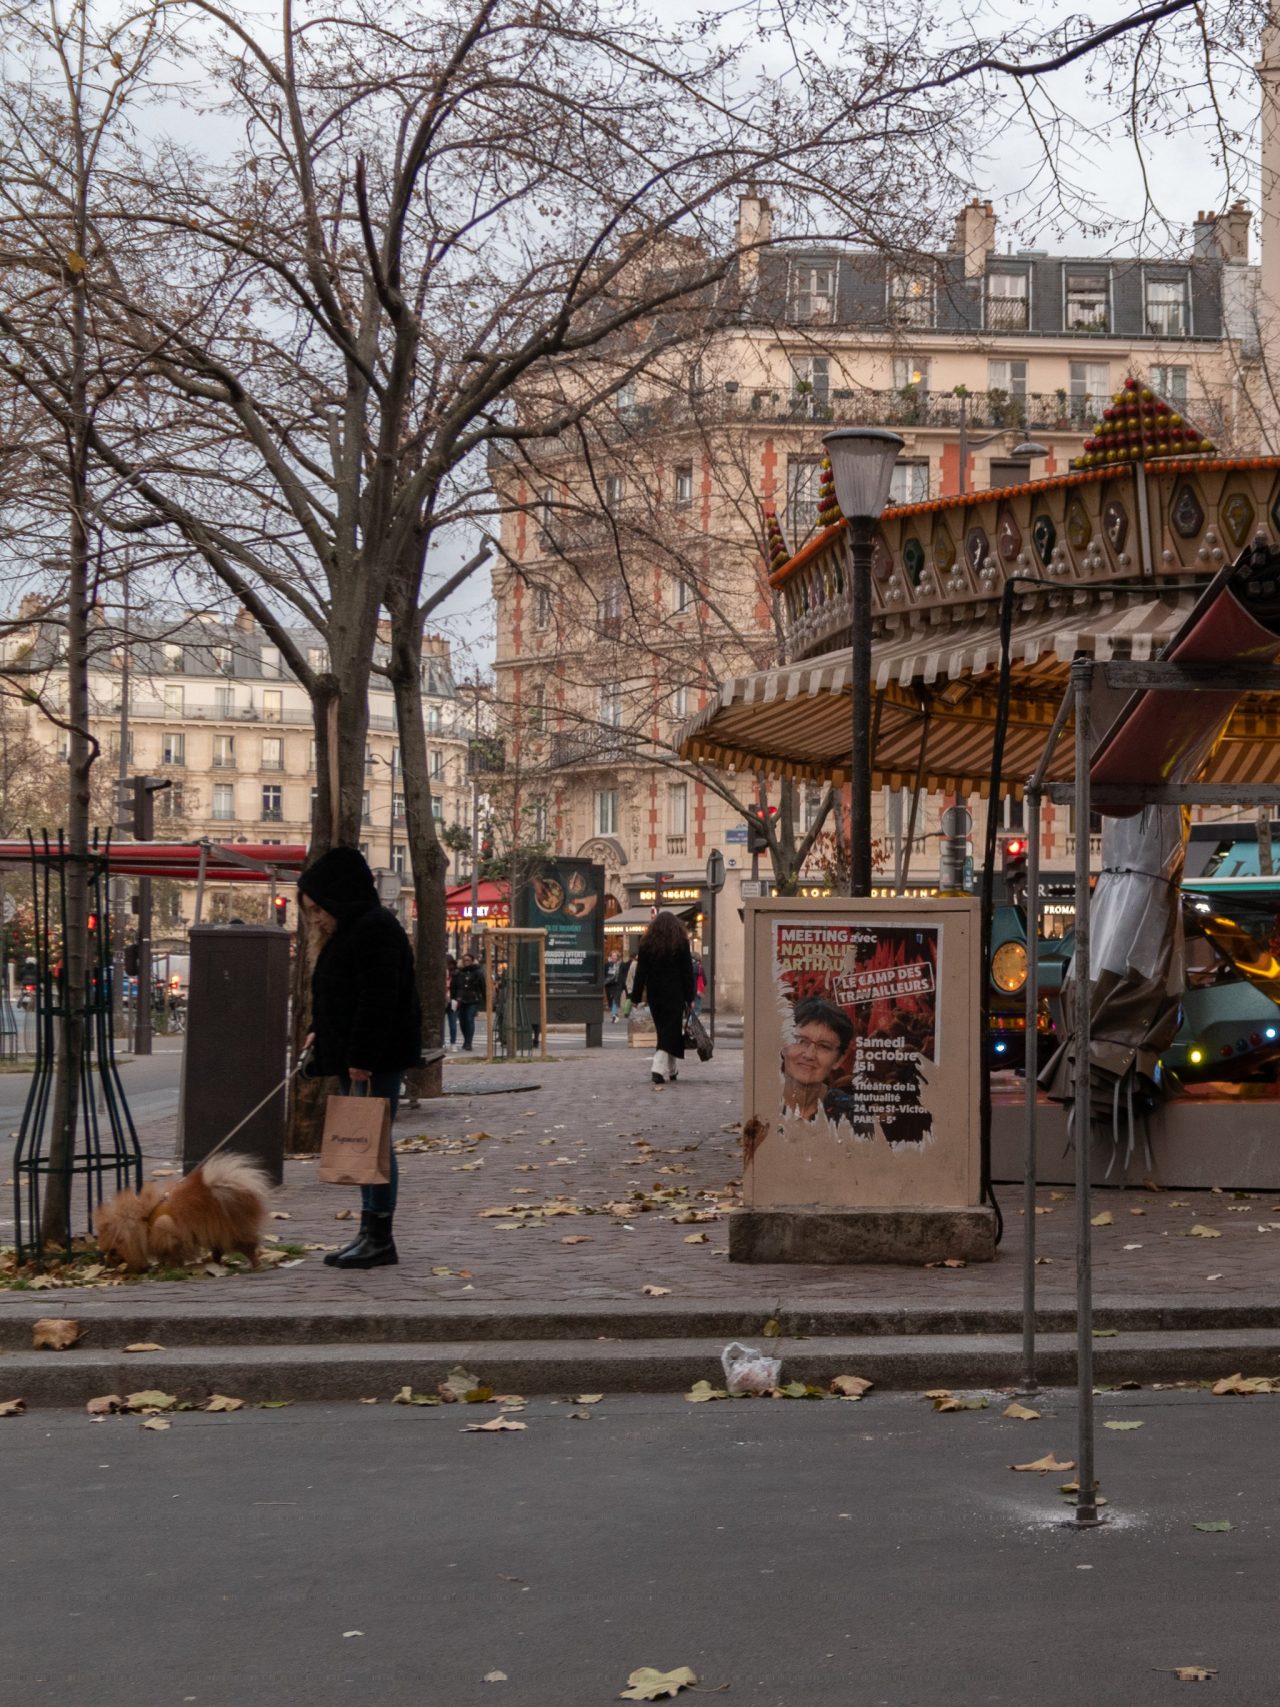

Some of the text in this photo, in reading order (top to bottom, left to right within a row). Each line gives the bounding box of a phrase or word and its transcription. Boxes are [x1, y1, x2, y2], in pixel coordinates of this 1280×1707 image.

[782, 929, 878, 944] MEETING avec
[842, 966, 922, 990] LE CAMP DES
[838, 979, 930, 1003] TRAVAILLEURS
[855, 1036, 905, 1048] Samedi
[855, 1049, 918, 1061] 8 octobre
[867, 1061, 875, 1072] h
[893, 1082, 906, 1091] de
[907, 1082, 916, 1091] la
[854, 1092, 901, 1103] Mutualité
[853, 1104, 868, 1114] 24,
[869, 1105, 885, 1113] rue
